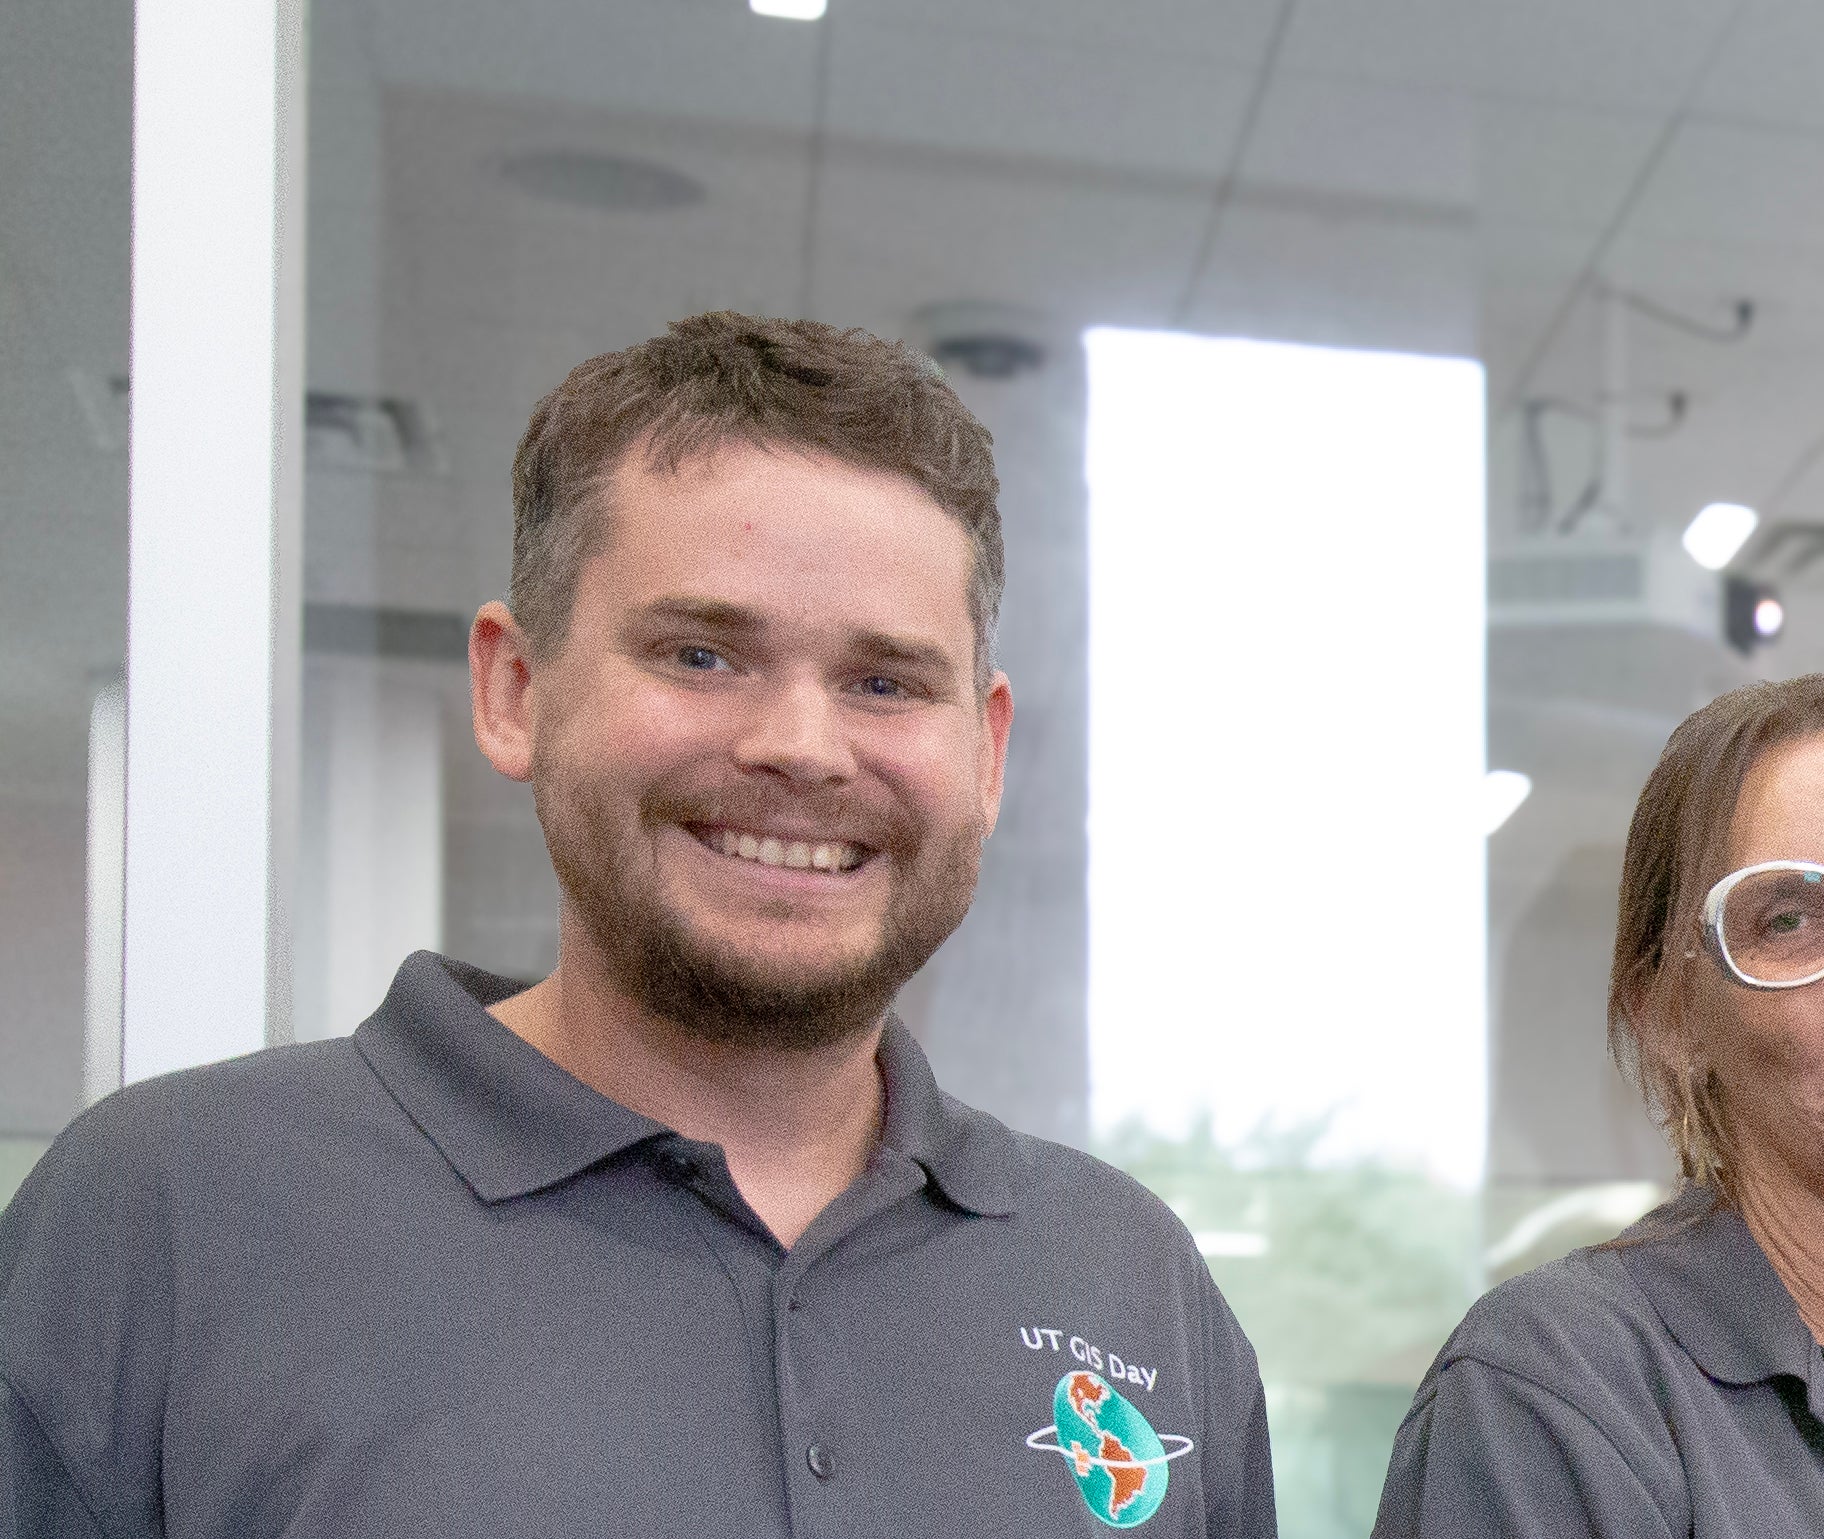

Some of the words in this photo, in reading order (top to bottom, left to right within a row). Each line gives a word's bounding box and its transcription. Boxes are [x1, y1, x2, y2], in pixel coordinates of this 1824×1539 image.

[1020, 1326, 1063, 1351] UT
[1070, 1336, 1103, 1371] GIS
[1108, 1353, 1158, 1392] Day
